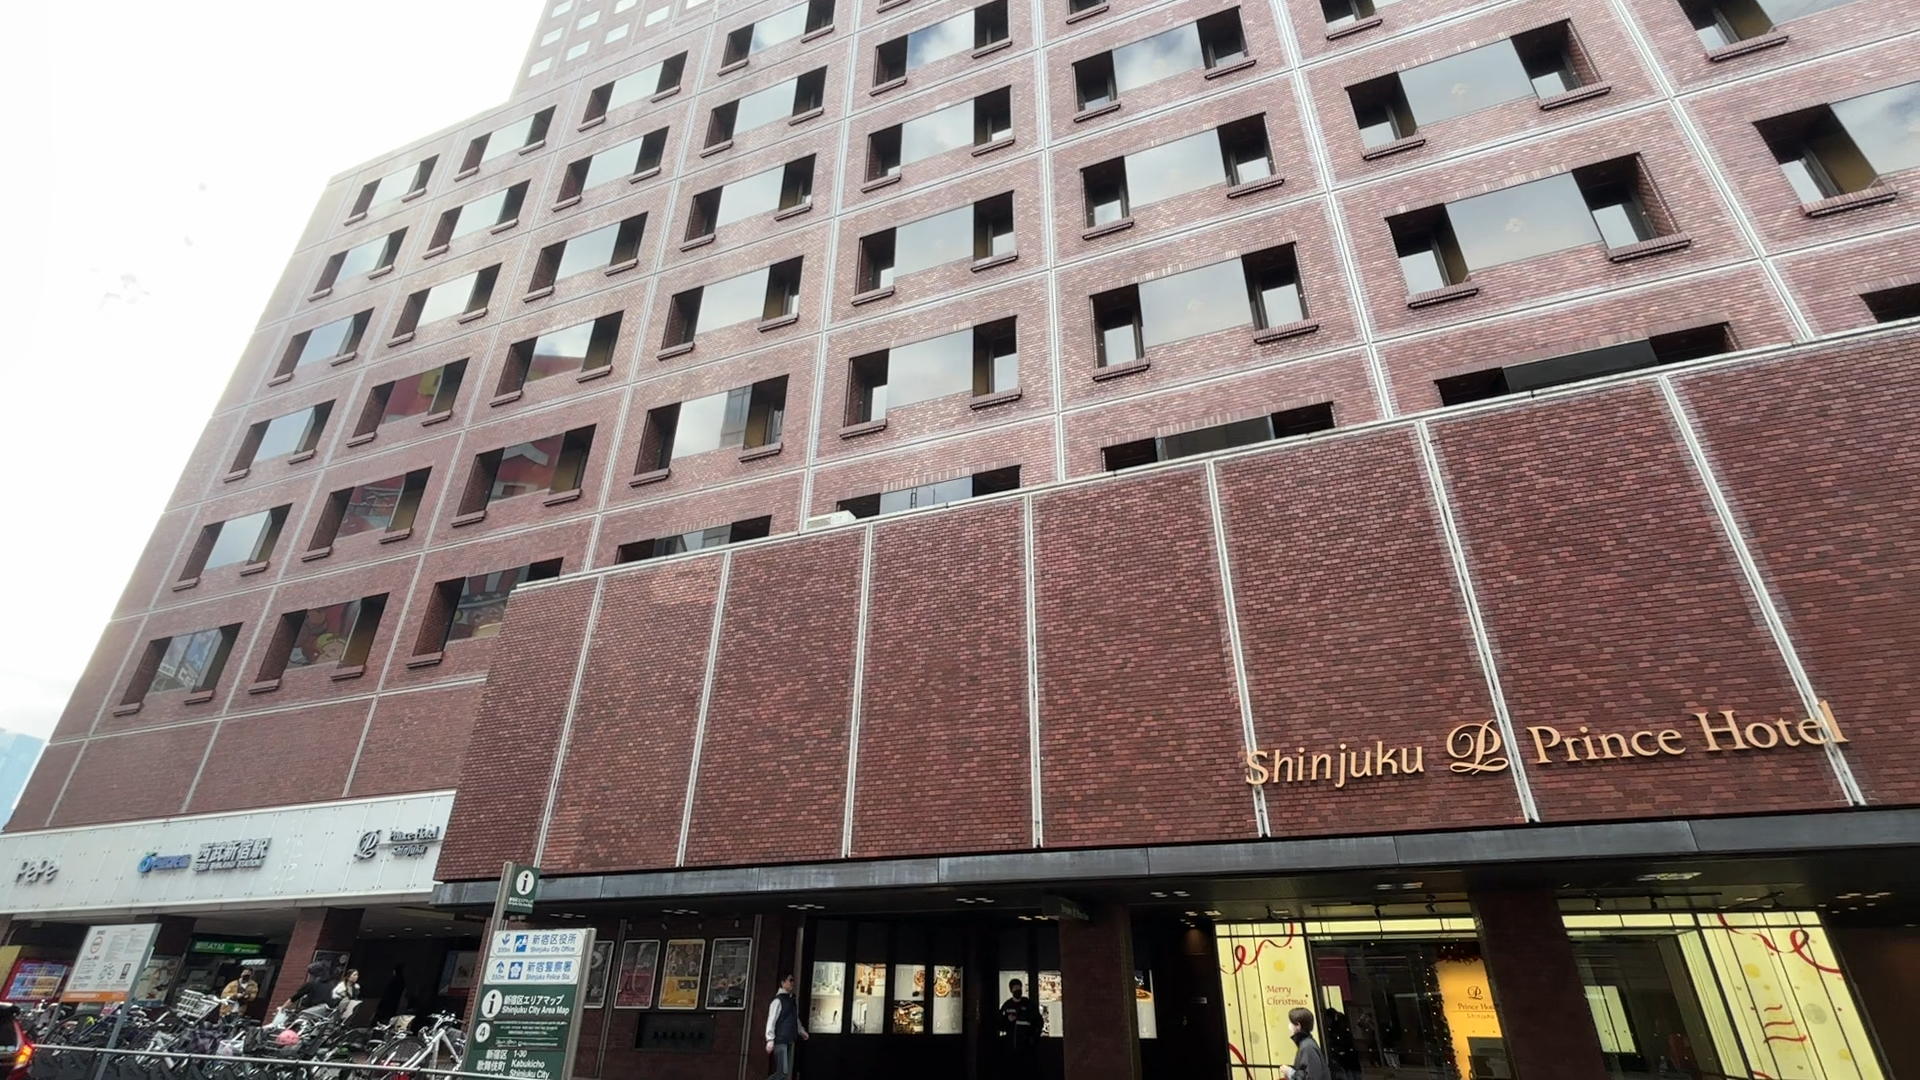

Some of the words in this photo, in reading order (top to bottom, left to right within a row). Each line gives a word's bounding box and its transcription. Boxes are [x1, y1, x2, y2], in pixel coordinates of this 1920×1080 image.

[1245, 741, 1425, 789] Shinjuku
[1525, 725, 1686, 765] Prince
[1692, 700, 1850, 752] Hotel
[197, 838, 272, 863] 西武新宿駅
[532, 933, 577, 945] 新宿区役所
[530, 946, 550, 954] Shinjuku
[1265, 985, 1291, 997] Merry
[503, 994, 565, 1006] 新宿区エリアマップ
[1266, 995, 1308, 1006] Christmas
[501, 1006, 527, 1015] Shinjuku
[528, 1006, 541, 1015] City
[541, 1006, 555, 1014] Area
[556, 1006, 570, 1016] Map
[511, 1060, 545, 1069] Kabukicho
